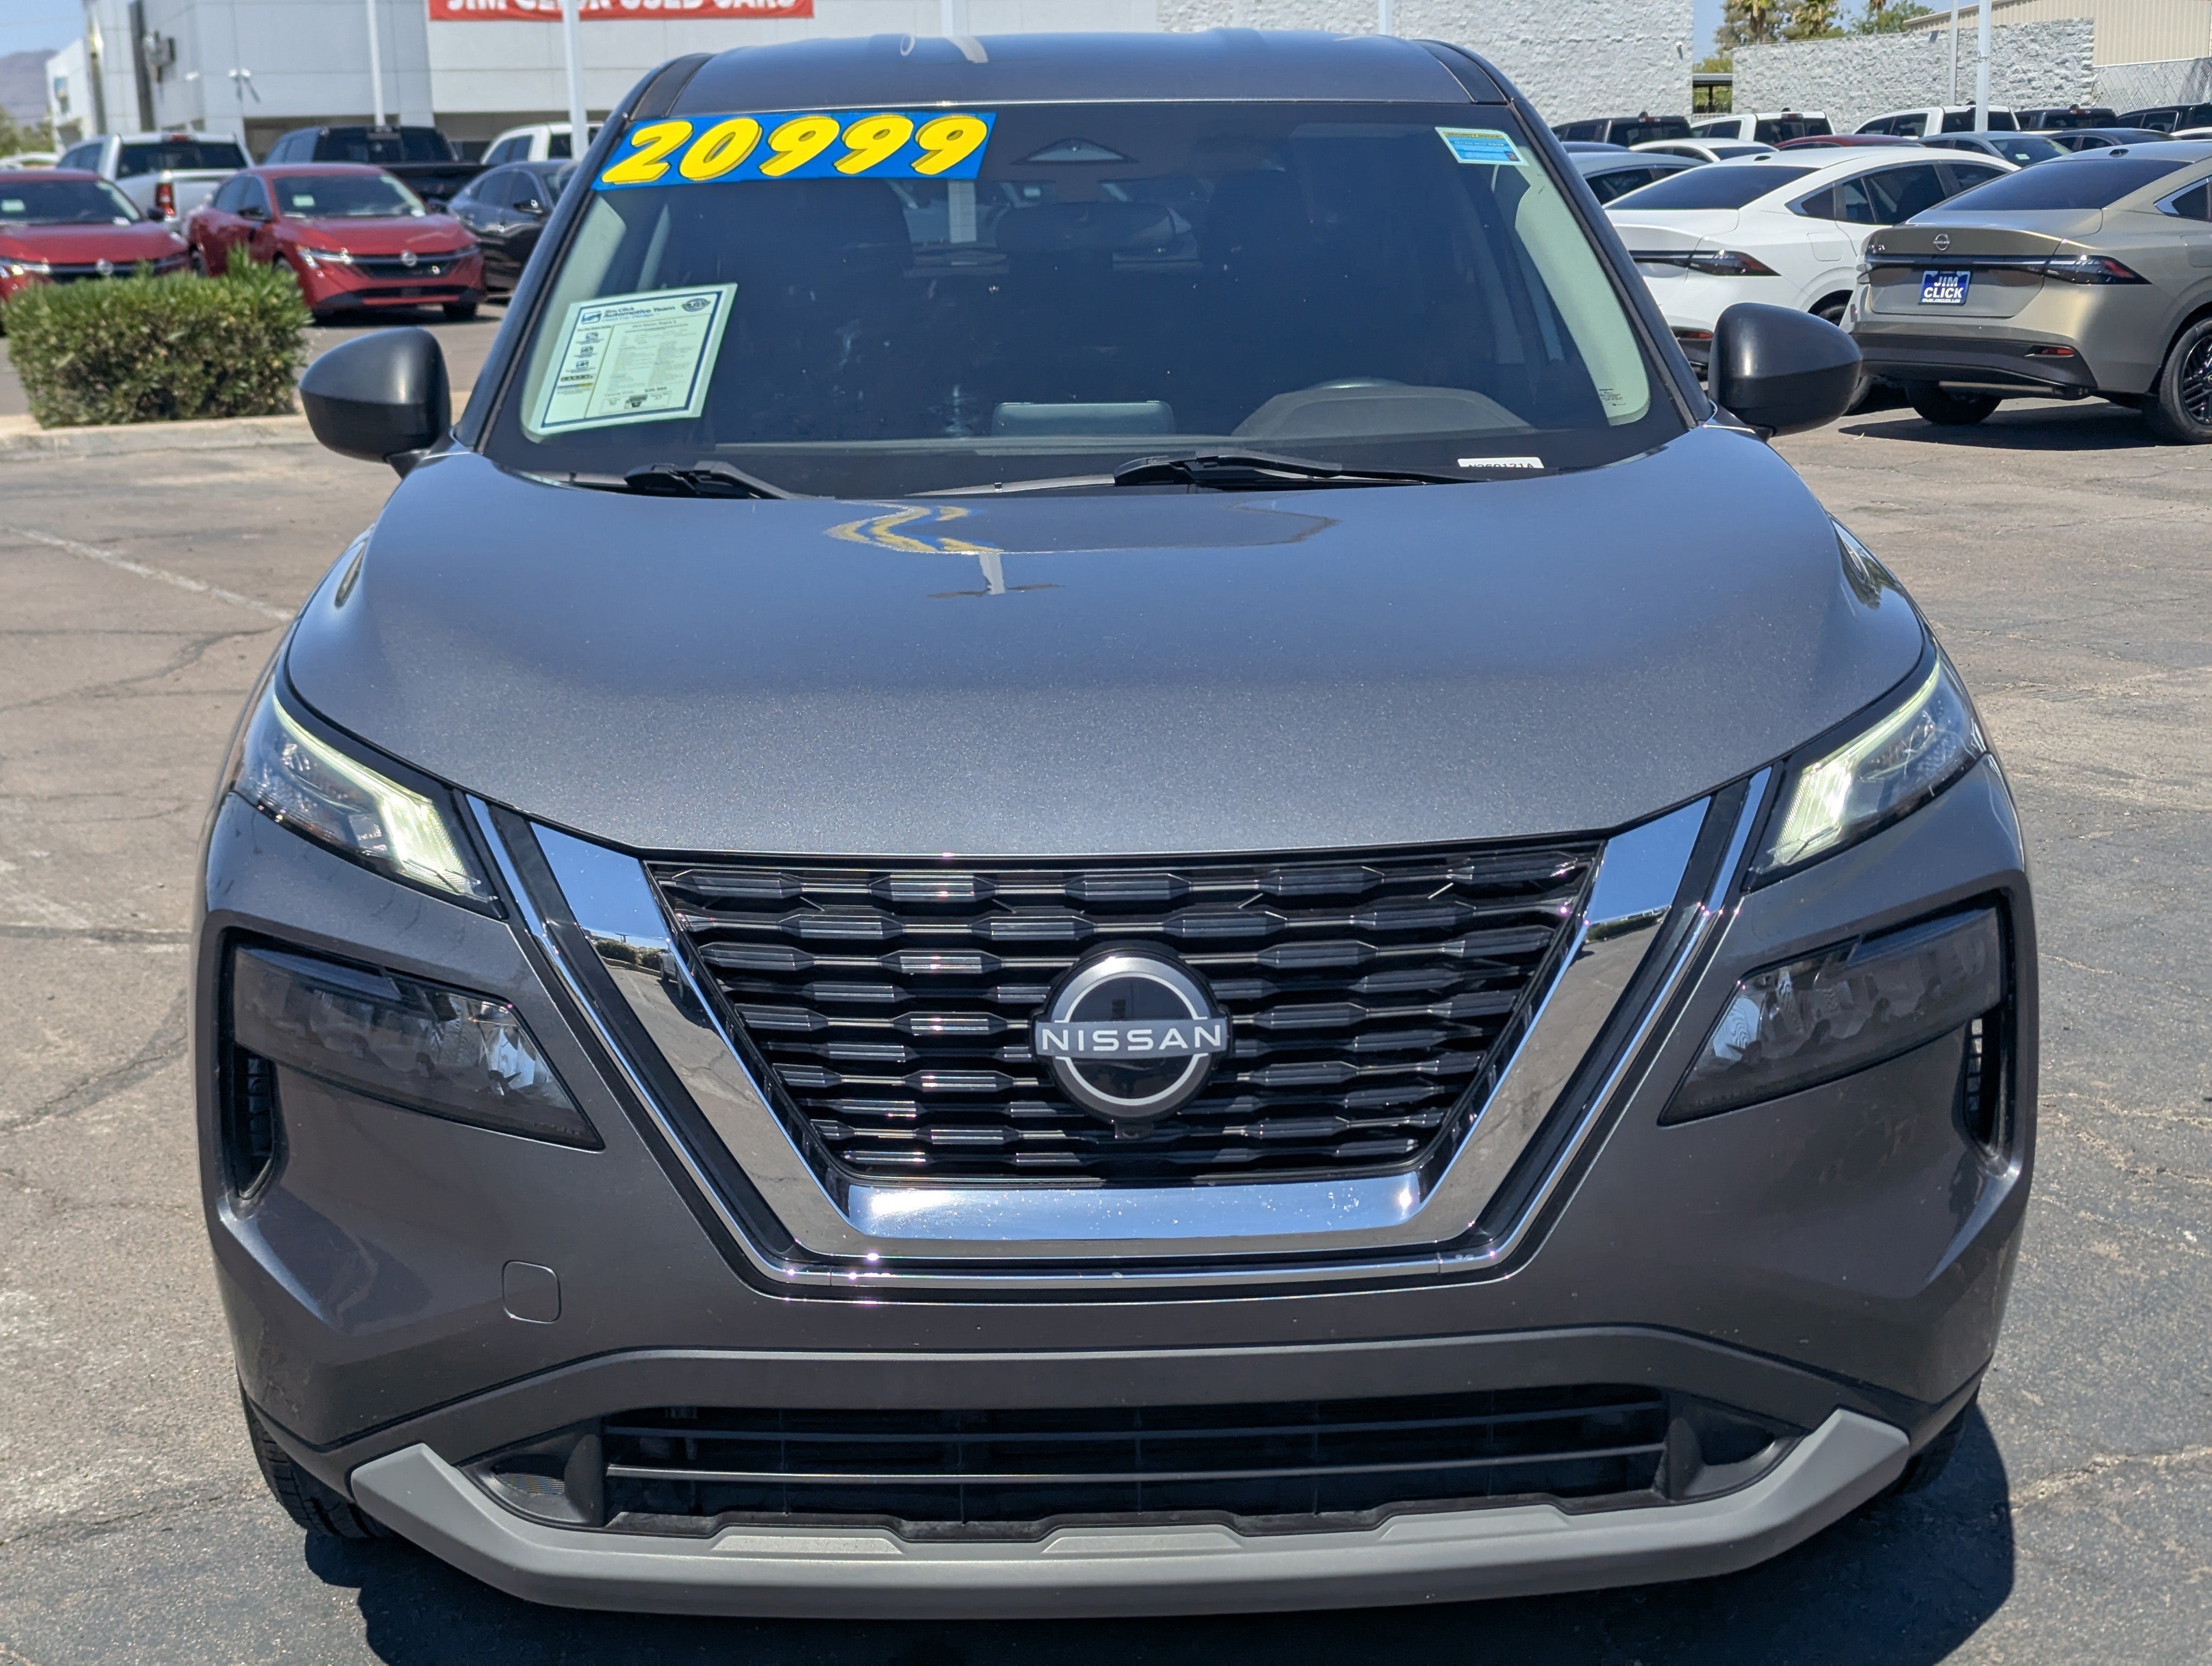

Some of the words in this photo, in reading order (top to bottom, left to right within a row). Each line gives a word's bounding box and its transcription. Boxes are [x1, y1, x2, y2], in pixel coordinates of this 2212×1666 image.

[602, 114, 988, 185] 20999
[1934, 276, 1959, 287] JIM
[1924, 286, 1964, 298] CLICK
[1041, 1024, 1221, 1052] NISSAN
